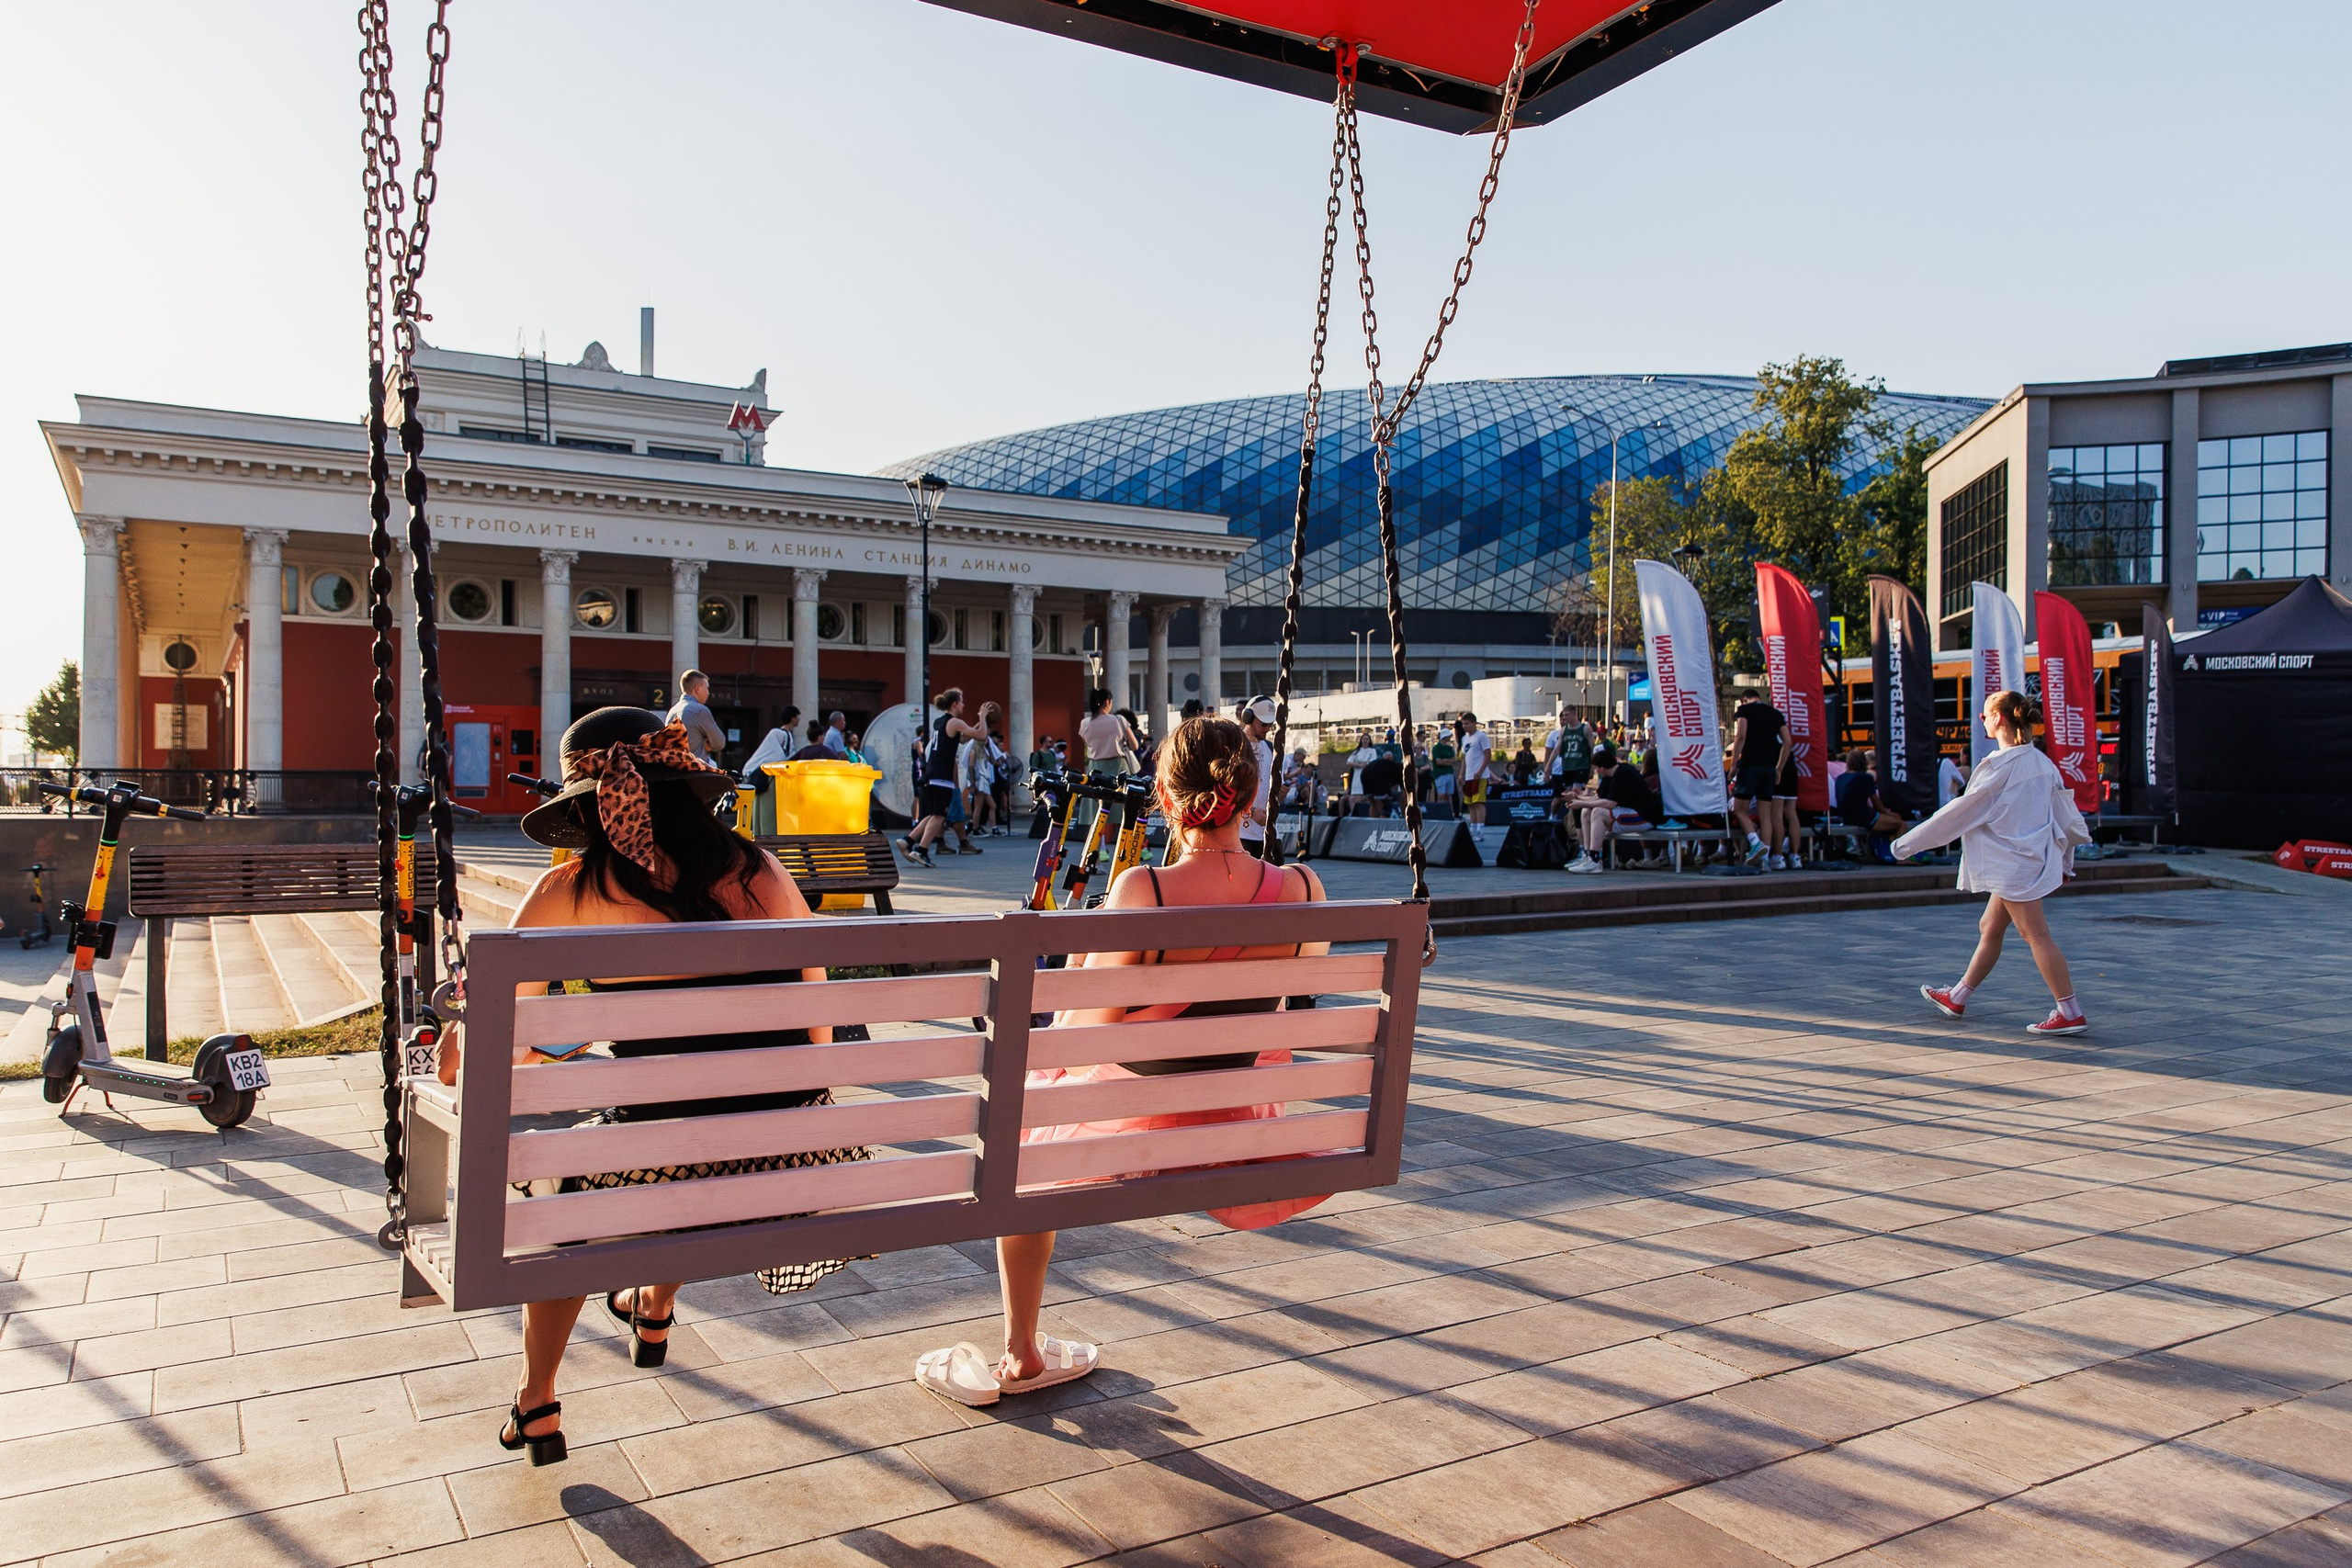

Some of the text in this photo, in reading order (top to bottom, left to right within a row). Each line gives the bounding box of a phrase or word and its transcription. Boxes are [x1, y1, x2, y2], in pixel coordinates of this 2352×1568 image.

[427, 514, 596, 540] ЕТРОПОЛИТЕН
[772, 543, 844, 558] ЛЕНИНА
[864, 550, 948, 568] СТАНЦИЯ
[960, 558, 1032, 574] ДИНАМО
[2206, 611, 2225, 621] VIP
[1766, 635, 1789, 727] СКОВСКИЙ
[2205, 652, 2314, 671] МОСКОВСКИЙ СПОРТ
[653, 688, 664, 704] 2
[1651, 634, 1684, 738] МОСКОВСКИЙ
[1888, 617, 1907, 783] STREETBASKET
[2044, 657, 2067, 746] МОСКОВСКИЙ
[1679, 688, 1704, 738] СПОРТ
[1789, 688, 1810, 737] СПОРТ
[2066, 704, 2086, 747] СПОРТ
[2145, 638, 2159, 786] STREETBASKET
[1500, 788, 1555, 800] STREETBASK
[1380, 830, 1413, 840] МОСКОВСК
[230, 1053, 263, 1072] KB2
[236, 1070, 266, 1089] 18A
